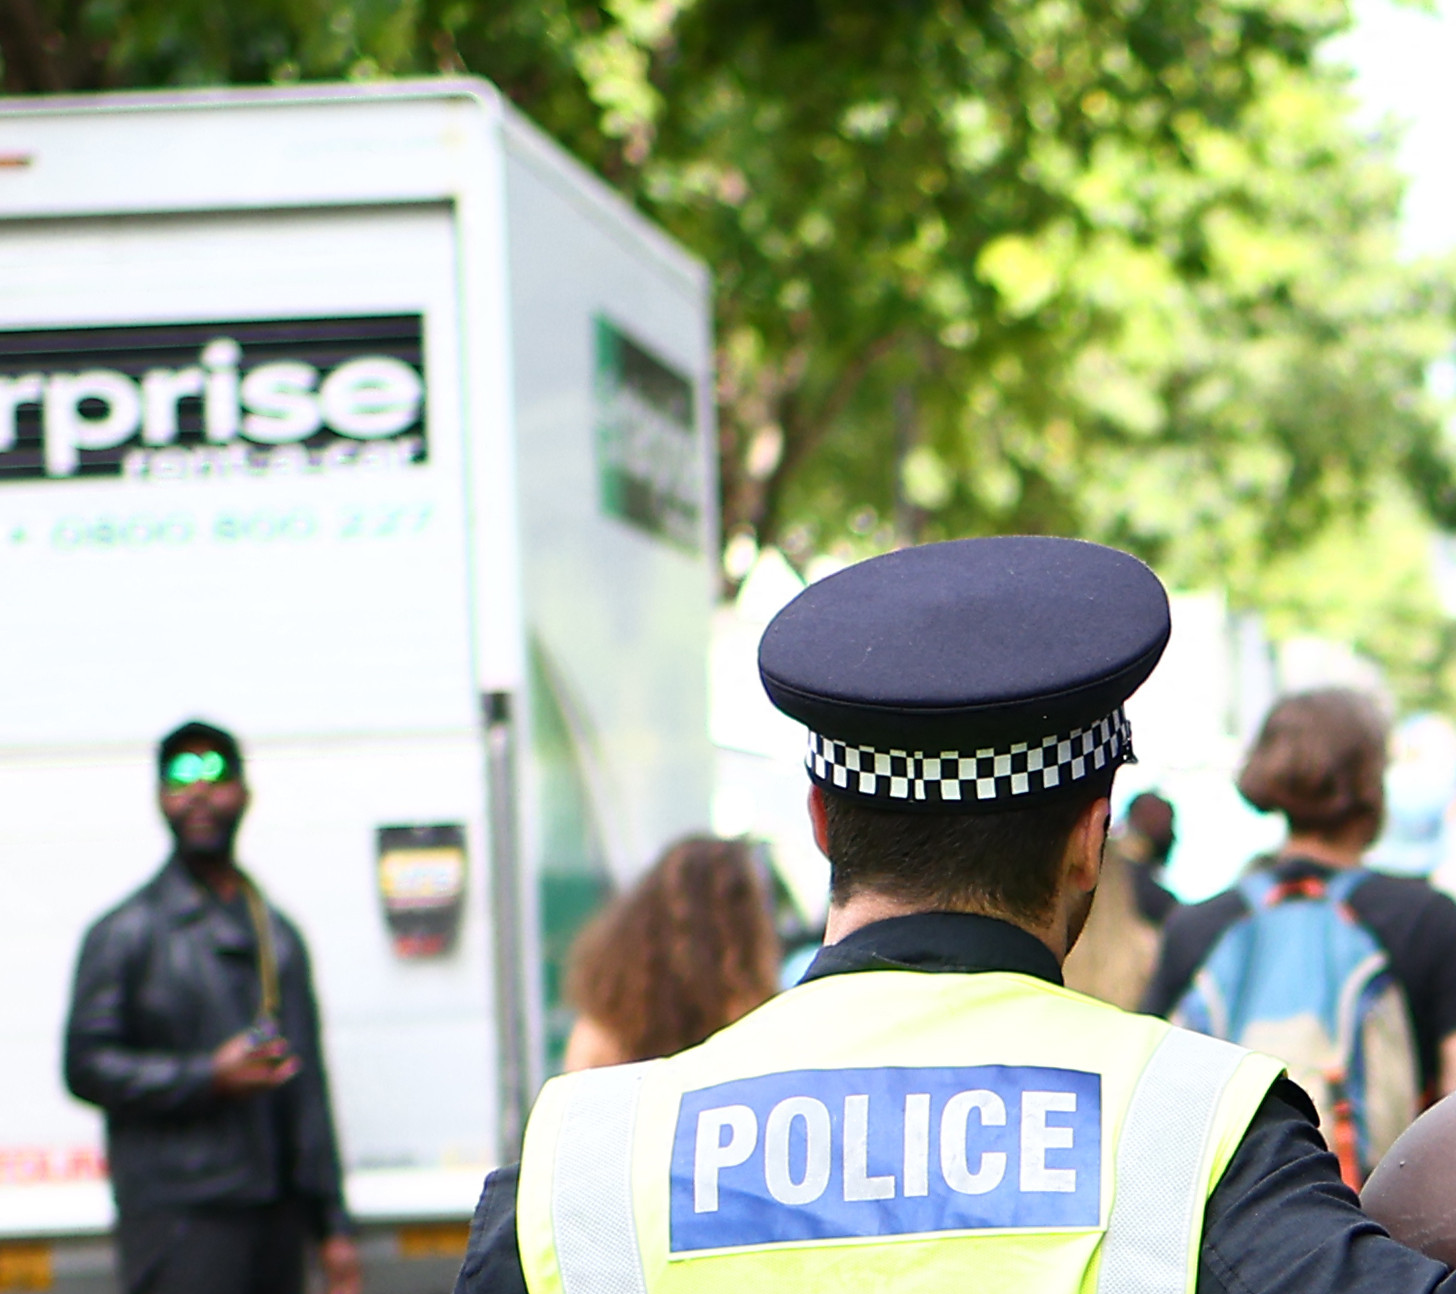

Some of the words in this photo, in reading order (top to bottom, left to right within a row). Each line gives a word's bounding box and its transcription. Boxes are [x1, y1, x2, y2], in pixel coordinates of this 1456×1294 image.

[0, 336, 423, 476] rprise
[211, 505, 319, 544] 800
[694, 1089, 1077, 1213] POLICE
